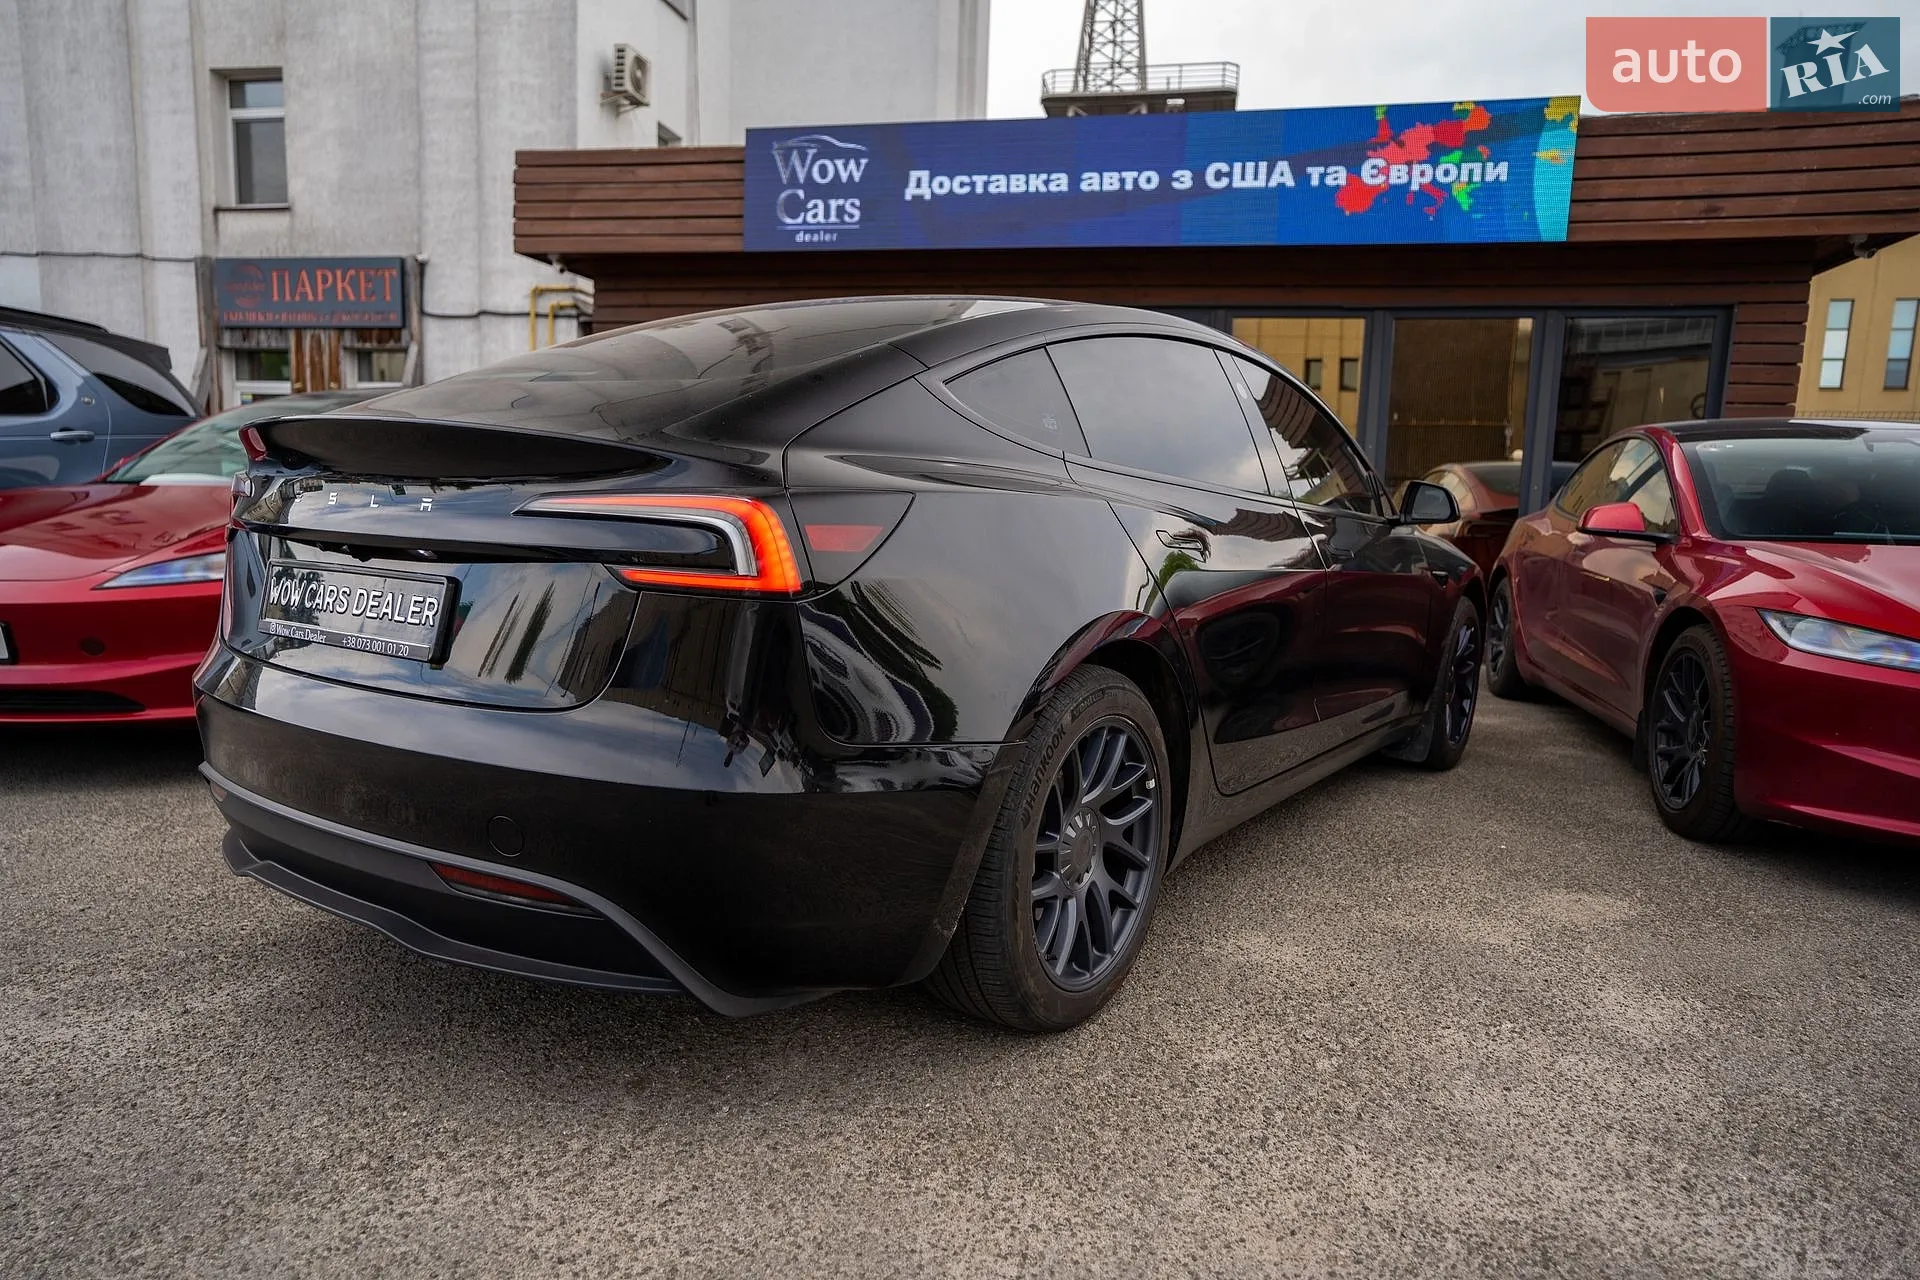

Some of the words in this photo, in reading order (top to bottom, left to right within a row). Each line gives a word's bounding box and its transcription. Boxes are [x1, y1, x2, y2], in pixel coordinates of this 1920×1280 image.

[772, 147, 868, 184] Wow
[904, 169, 1069, 201] Доставка
[1080, 170, 1159, 191] авто
[1171, 169, 1193, 190] з
[1205, 160, 1295, 189] США
[1306, 167, 1347, 187] та
[1361, 157, 1509, 192] Європи
[776, 189, 861, 225] Cars
[795, 230, 838, 243] dealer
[271, 268, 397, 302] ПАРКЕТ
[269, 576, 306, 608] WOW
[304, 582, 351, 614] CARS
[352, 588, 440, 627] DEALER
[342, 636, 357, 648] +38
[356, 638, 372, 651] 073
[371, 641, 386, 653] 001
[387, 643, 397, 655] 01
[399, 645, 409, 656] 20
